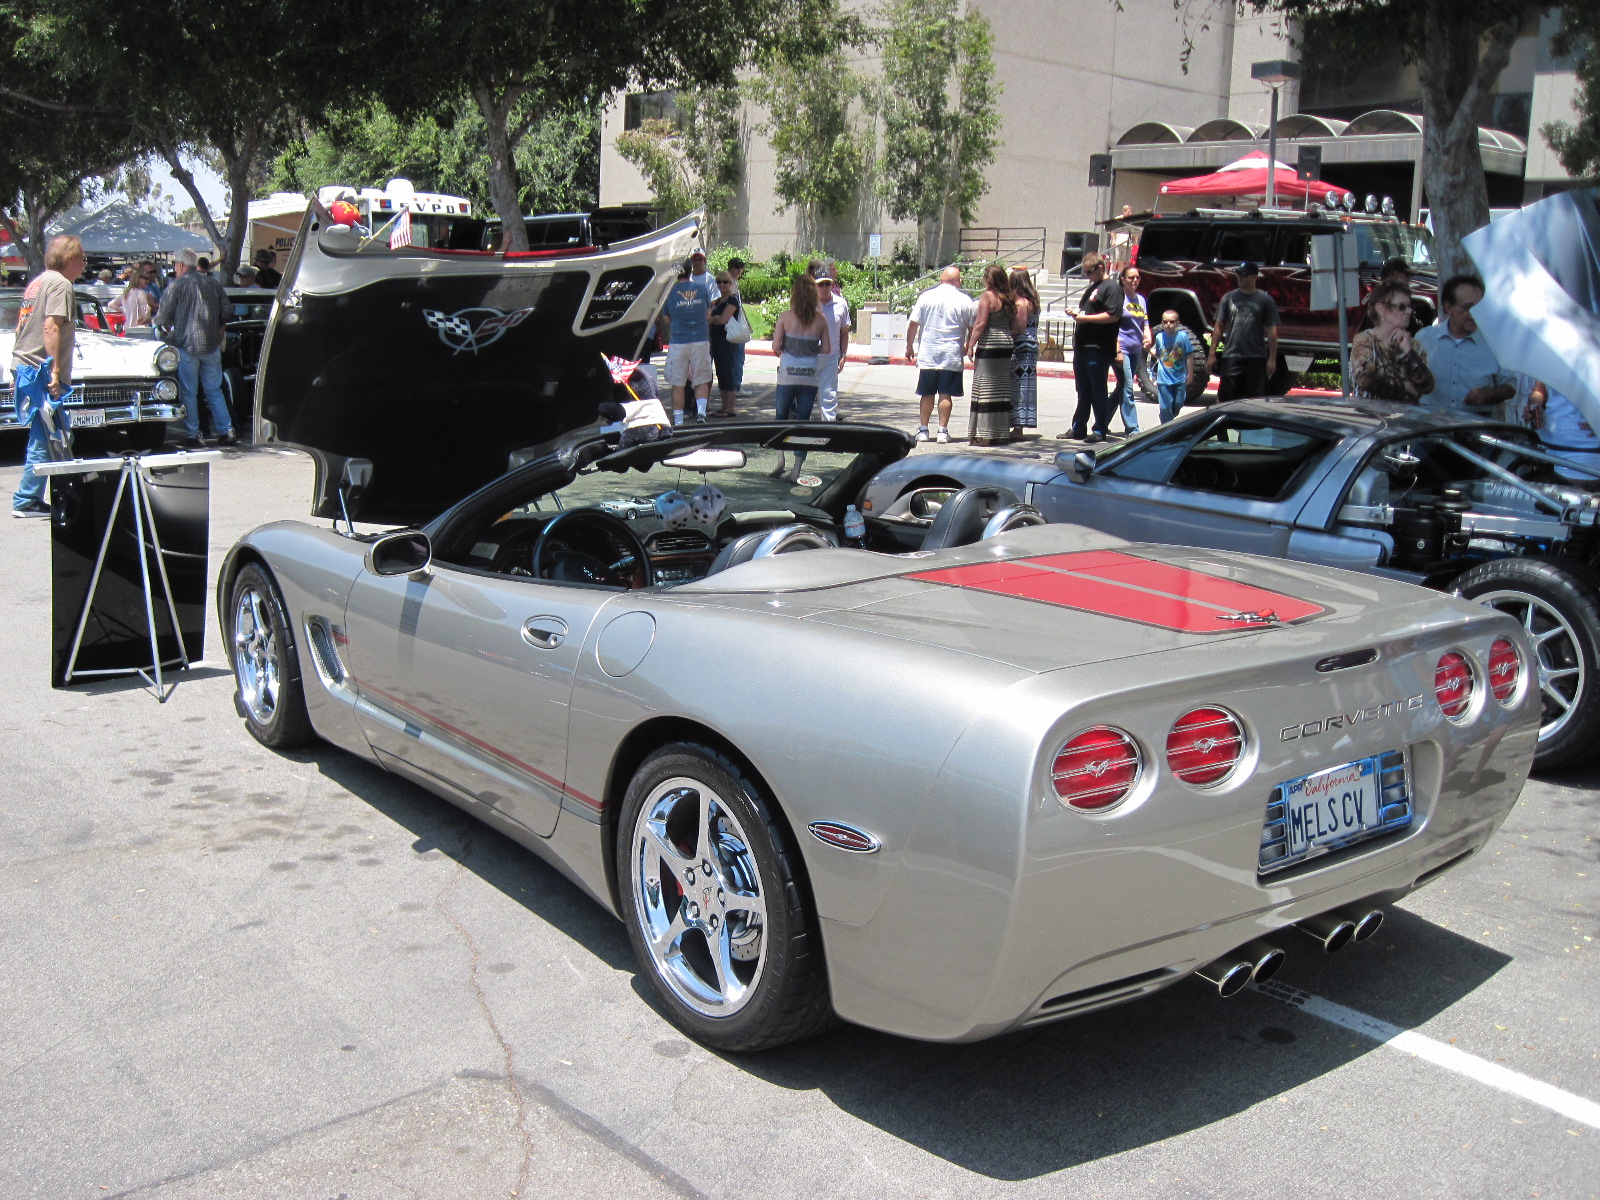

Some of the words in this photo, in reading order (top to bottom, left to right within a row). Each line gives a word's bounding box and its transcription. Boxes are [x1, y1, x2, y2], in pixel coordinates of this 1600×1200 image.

[275, 236, 297, 248] POLIC
[1279, 693, 1423, 742] CORVETTE
[1305, 773, 1361, 797] California
